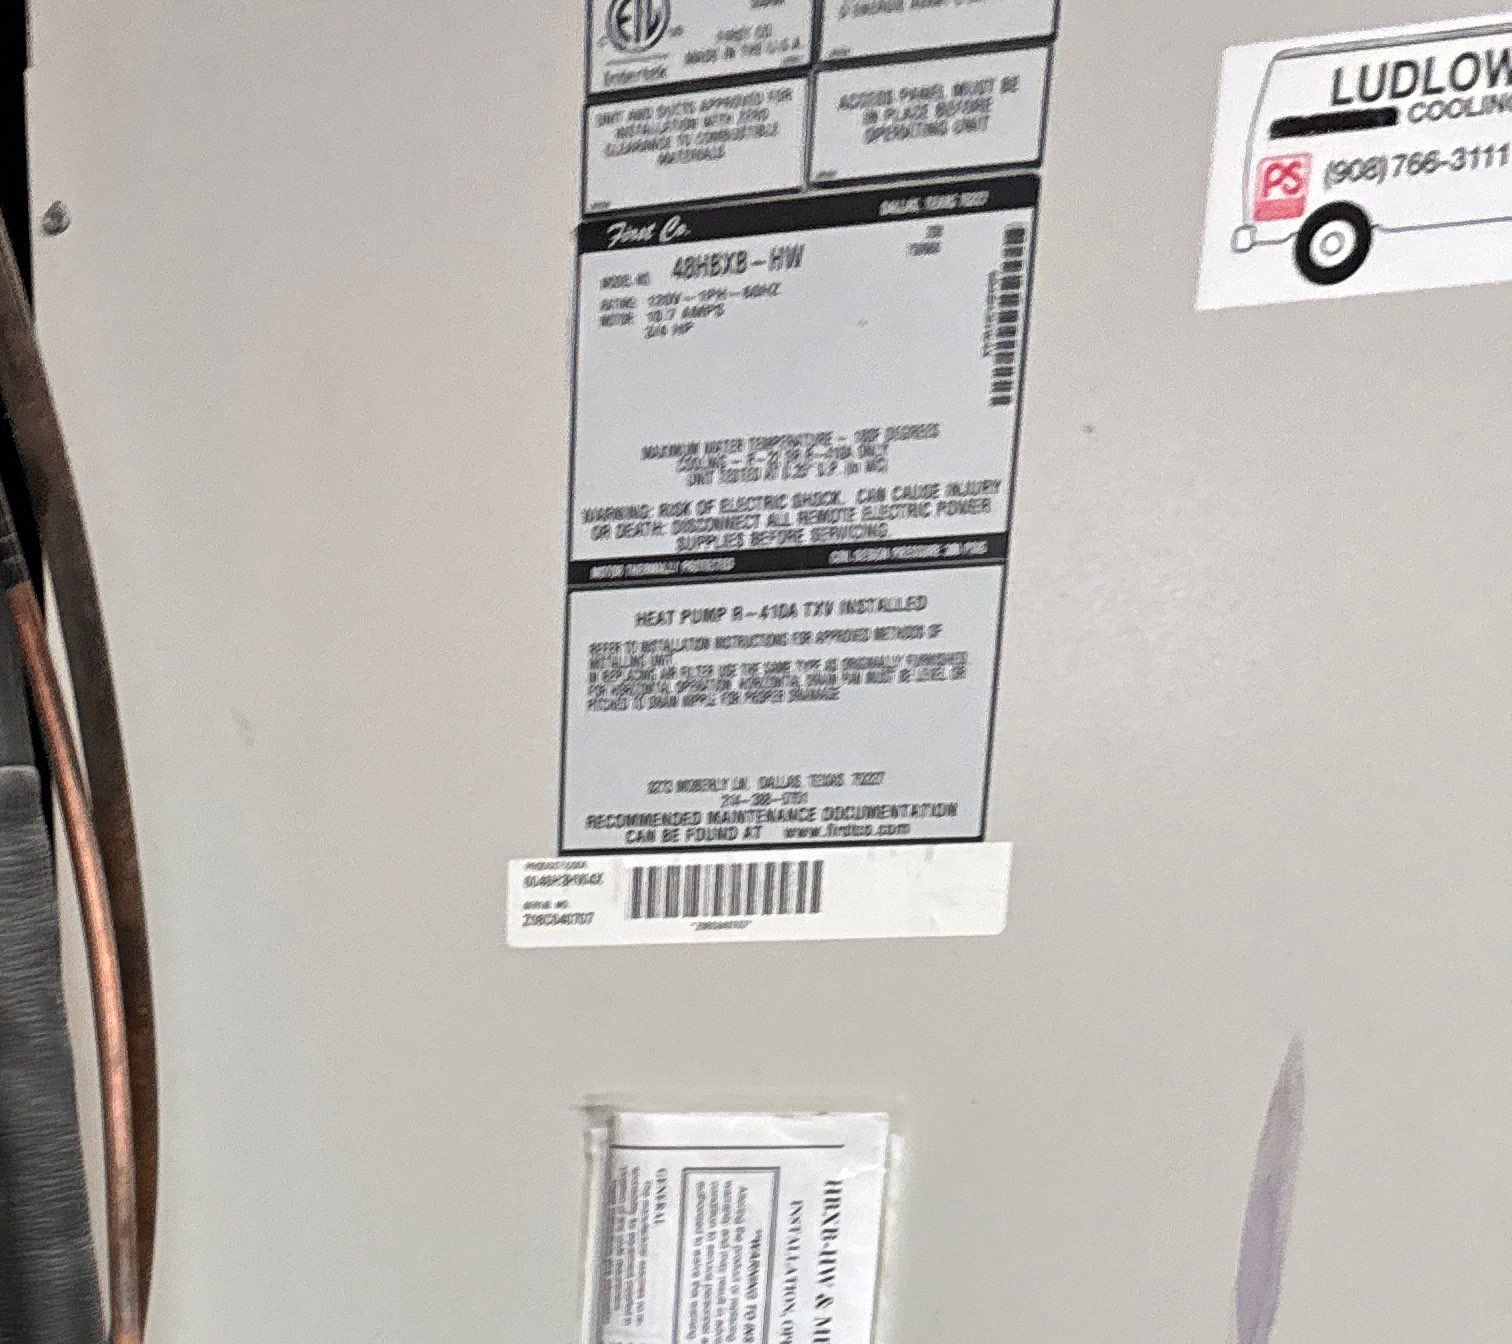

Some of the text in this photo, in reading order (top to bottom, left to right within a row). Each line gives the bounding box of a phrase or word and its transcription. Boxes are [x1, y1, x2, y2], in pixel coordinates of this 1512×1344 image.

[1330, 47, 1512, 105] LUDLOW
[635, 608, 675, 628] HEAT
[679, 605, 728, 626] PUMP
